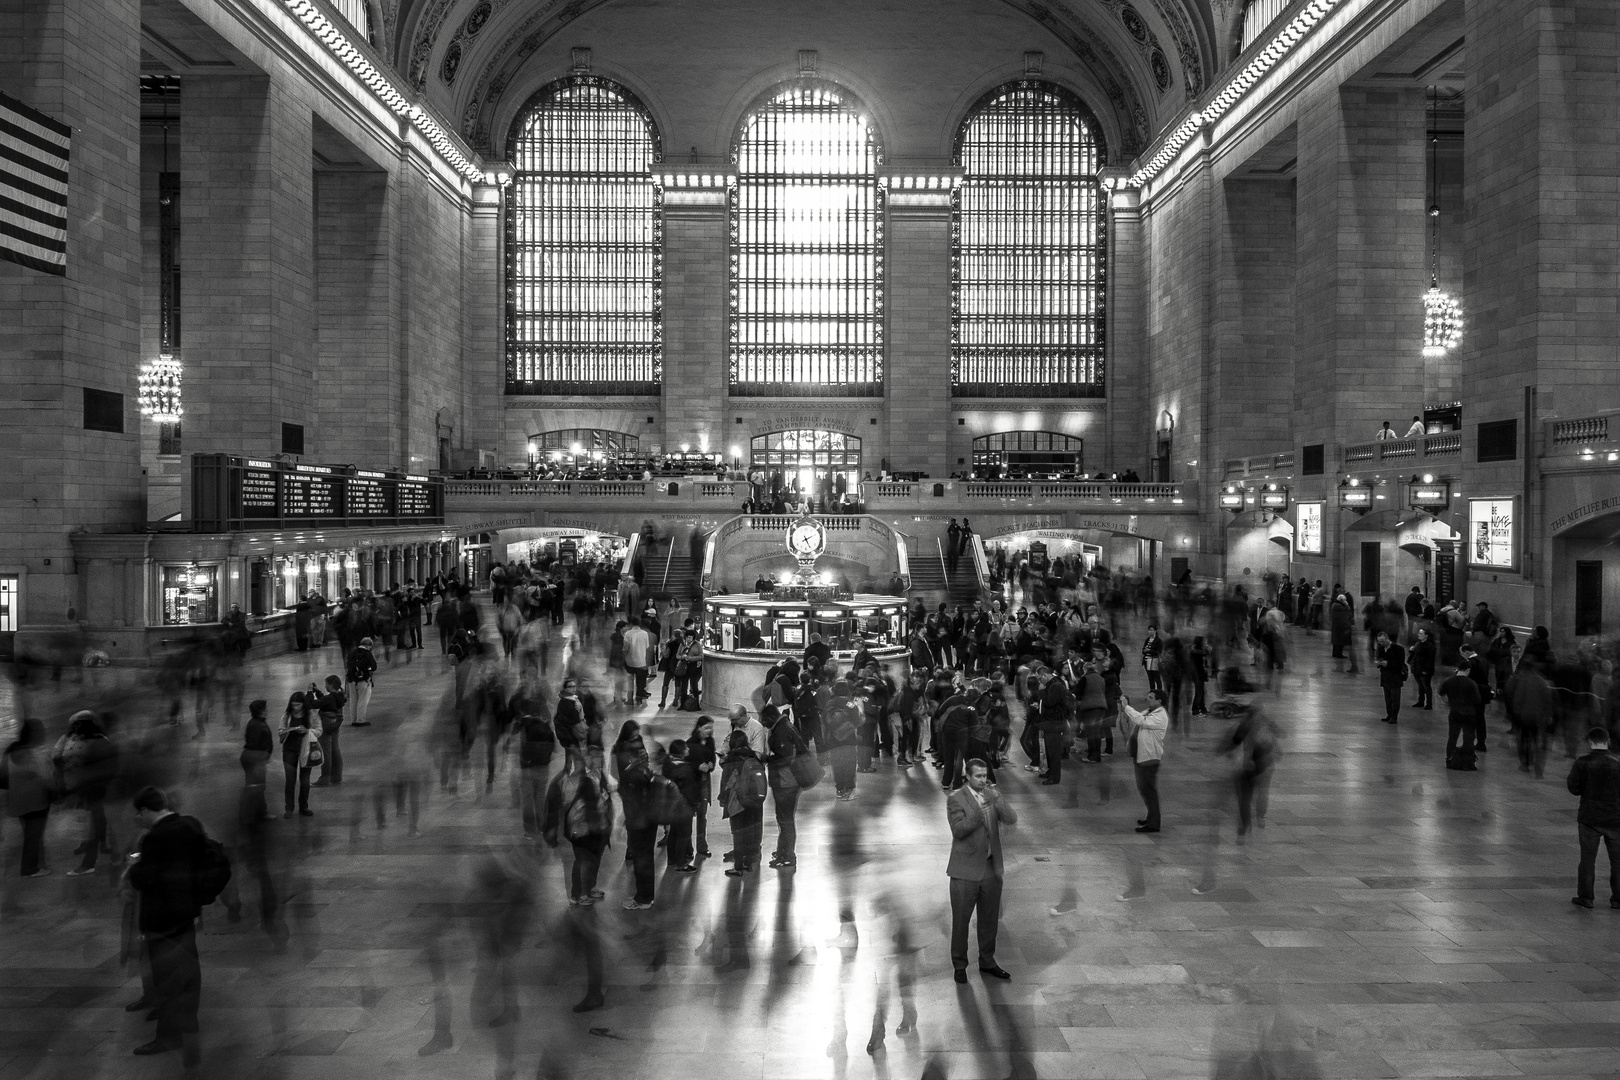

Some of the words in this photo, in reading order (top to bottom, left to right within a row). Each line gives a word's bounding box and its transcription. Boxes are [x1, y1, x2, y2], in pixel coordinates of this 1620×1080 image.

[775, 422, 811, 430] CAMPBELL
[814, 423, 856, 434] APARTMENT
[823, 417, 850, 427] AVENUE
[1551, 516, 1566, 531] THE
[1566, 501, 1600, 522] METLIFE
[1601, 496, 1620, 510] BUIL
[465, 521, 493, 532] SUBWAY
[495, 518, 527, 527] SHUTTLE
[553, 518, 571, 526] 42ND
[571, 520, 598, 530] STREET
[996, 523, 1021, 533] TICKET
[1022, 520, 1059, 529] MACHINES
[1082, 520, 1111, 529] TRACKS
[1119, 524, 1129, 532] TO
[542, 529, 567, 538] SUBWAY
[1037, 530, 1065, 539] WAITING
[1066, 533, 1084, 541] ROOM
